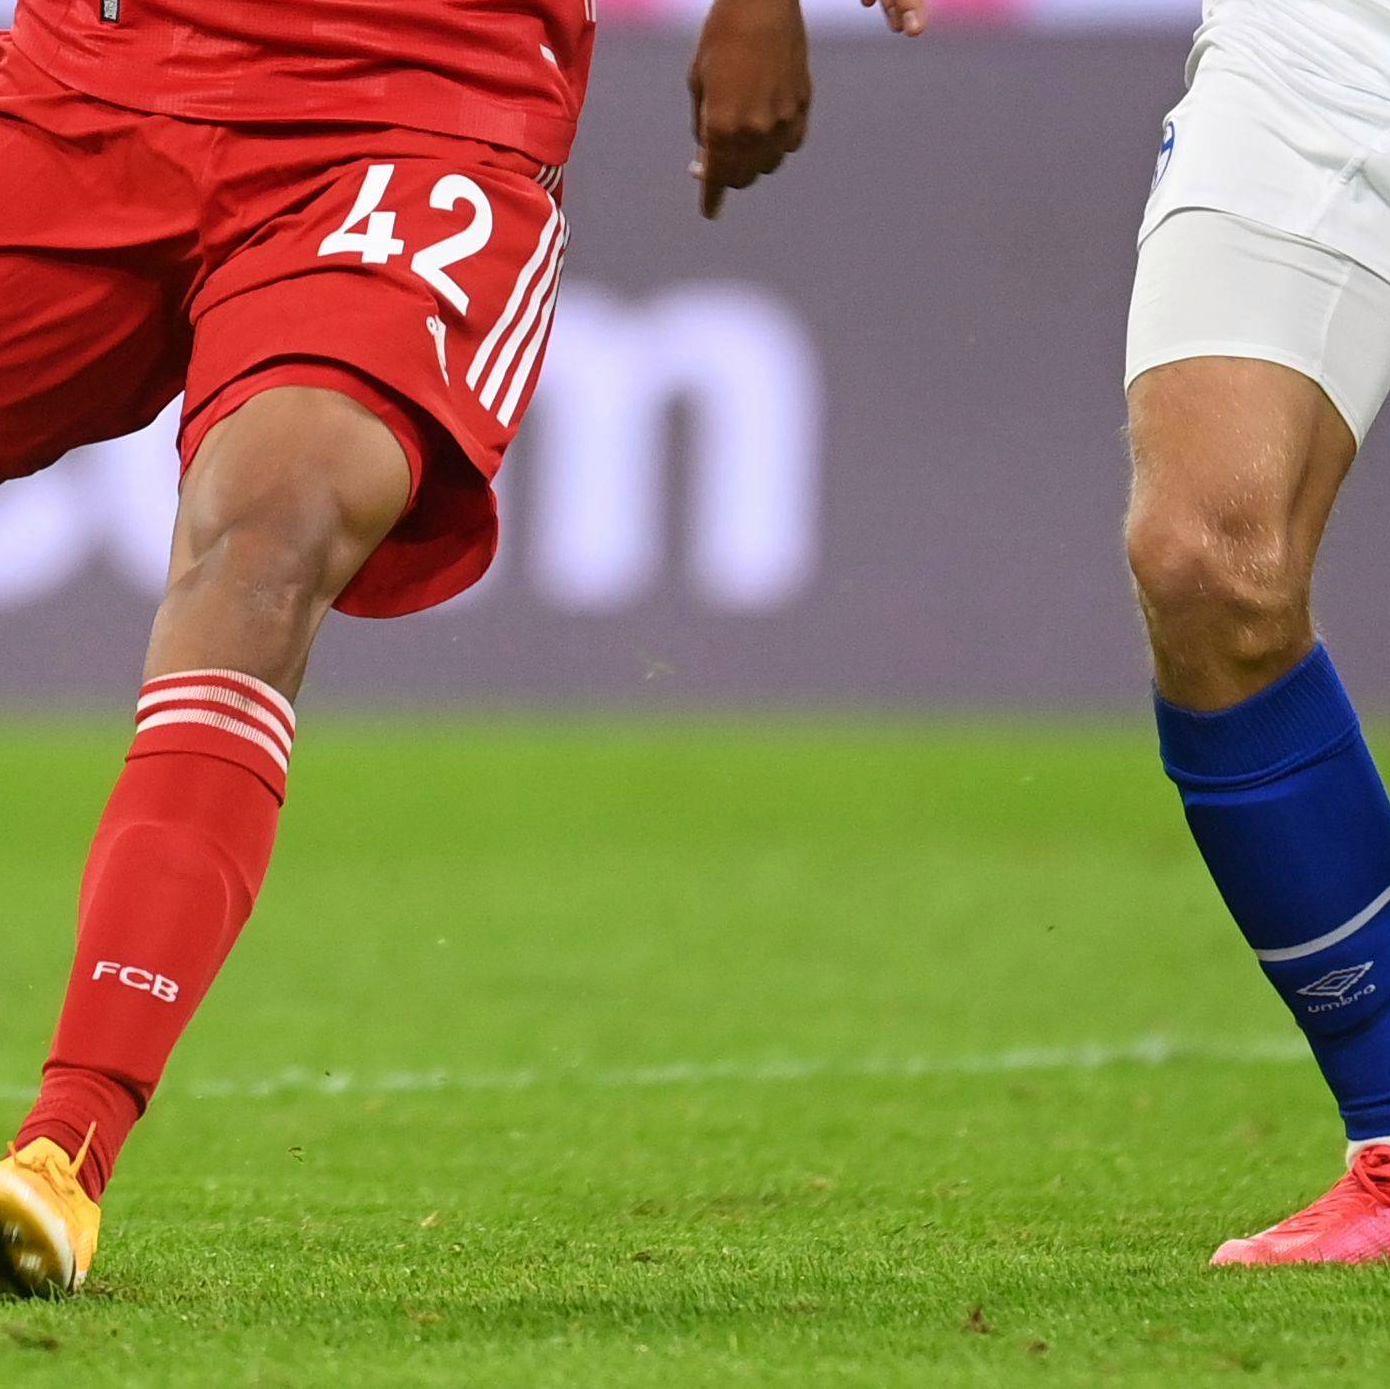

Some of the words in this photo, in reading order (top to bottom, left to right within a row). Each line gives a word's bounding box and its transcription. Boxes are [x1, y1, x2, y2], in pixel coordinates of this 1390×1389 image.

[317, 164, 492, 316] 42
[92, 961, 179, 1002] FCB
[1308, 984, 1376, 1013] umbro
